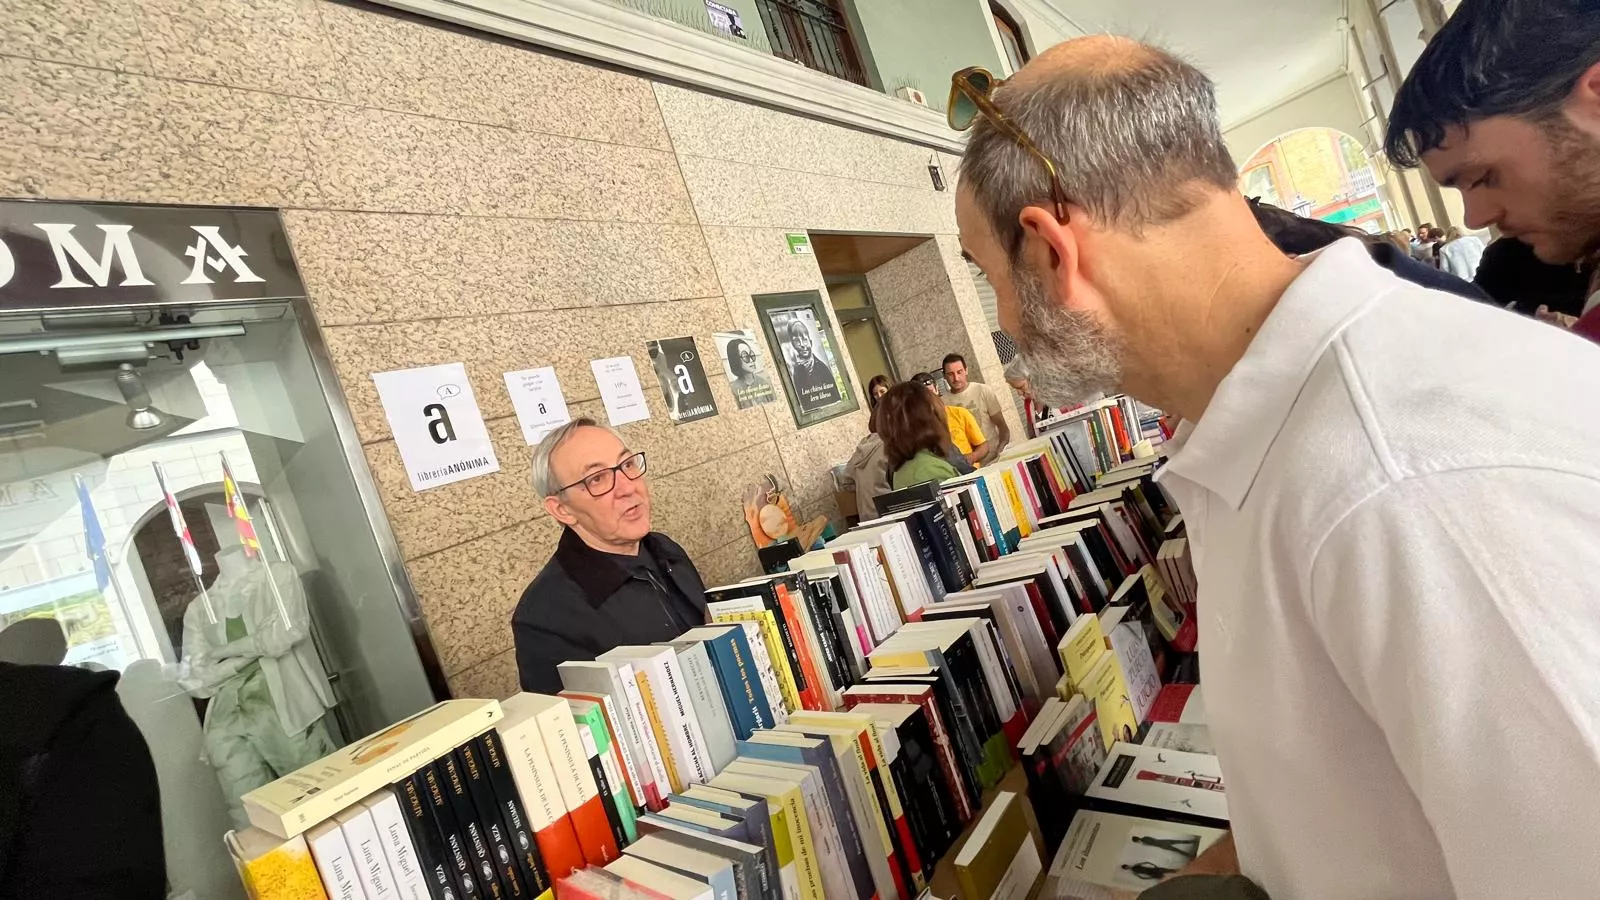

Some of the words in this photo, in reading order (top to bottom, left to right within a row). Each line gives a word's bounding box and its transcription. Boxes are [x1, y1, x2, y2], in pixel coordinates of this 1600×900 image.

[728, 637, 744, 667] poemas
[738, 666, 747, 680] los
[742, 679, 755, 704] Todos
[674, 694, 686, 717] MIGUEL
[681, 723, 694, 748] HOMBRE
[852, 738, 861, 754] final
[876, 743, 884, 758] vida
[859, 760, 868, 775] vida
[506, 799, 523, 829] NEUMAN
[789, 797, 802, 834] inocencia
[467, 821, 486, 858] QUINTANA
[490, 822, 502, 842] REZA
[797, 833, 804, 845] mi
[387, 822, 402, 846] Luna
[396, 845, 415, 877] Miguel
[447, 833, 467, 871] QUINTANA
[800, 845, 807, 856] de
[330, 855, 346, 881] Luna
[340, 880, 353, 900] Mig
[359, 838, 375, 864] Luna
[369, 862, 388, 896] Miguel
[434, 863, 447, 884] REZA
[804, 856, 816, 889] pruebas
